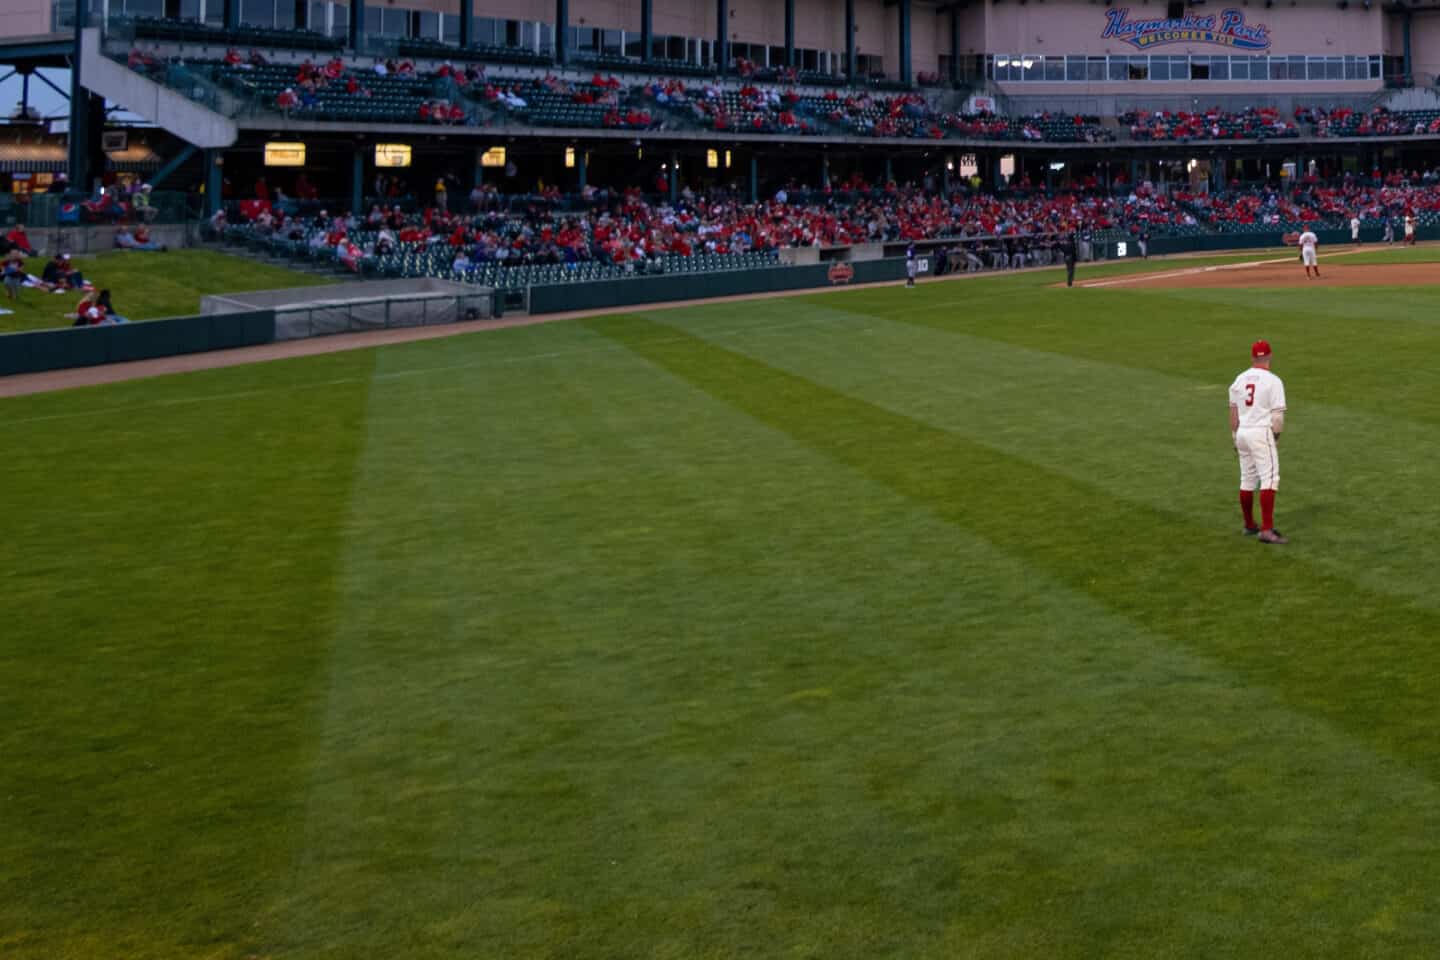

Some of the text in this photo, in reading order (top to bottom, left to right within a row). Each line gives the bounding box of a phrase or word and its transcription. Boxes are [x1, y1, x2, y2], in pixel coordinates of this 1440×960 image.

[1102, 8, 1267, 40] Haymarket Park
[1212, 31, 1234, 44] YOU
[917, 259, 929, 272] 10
[1245, 383, 1255, 407] 3
